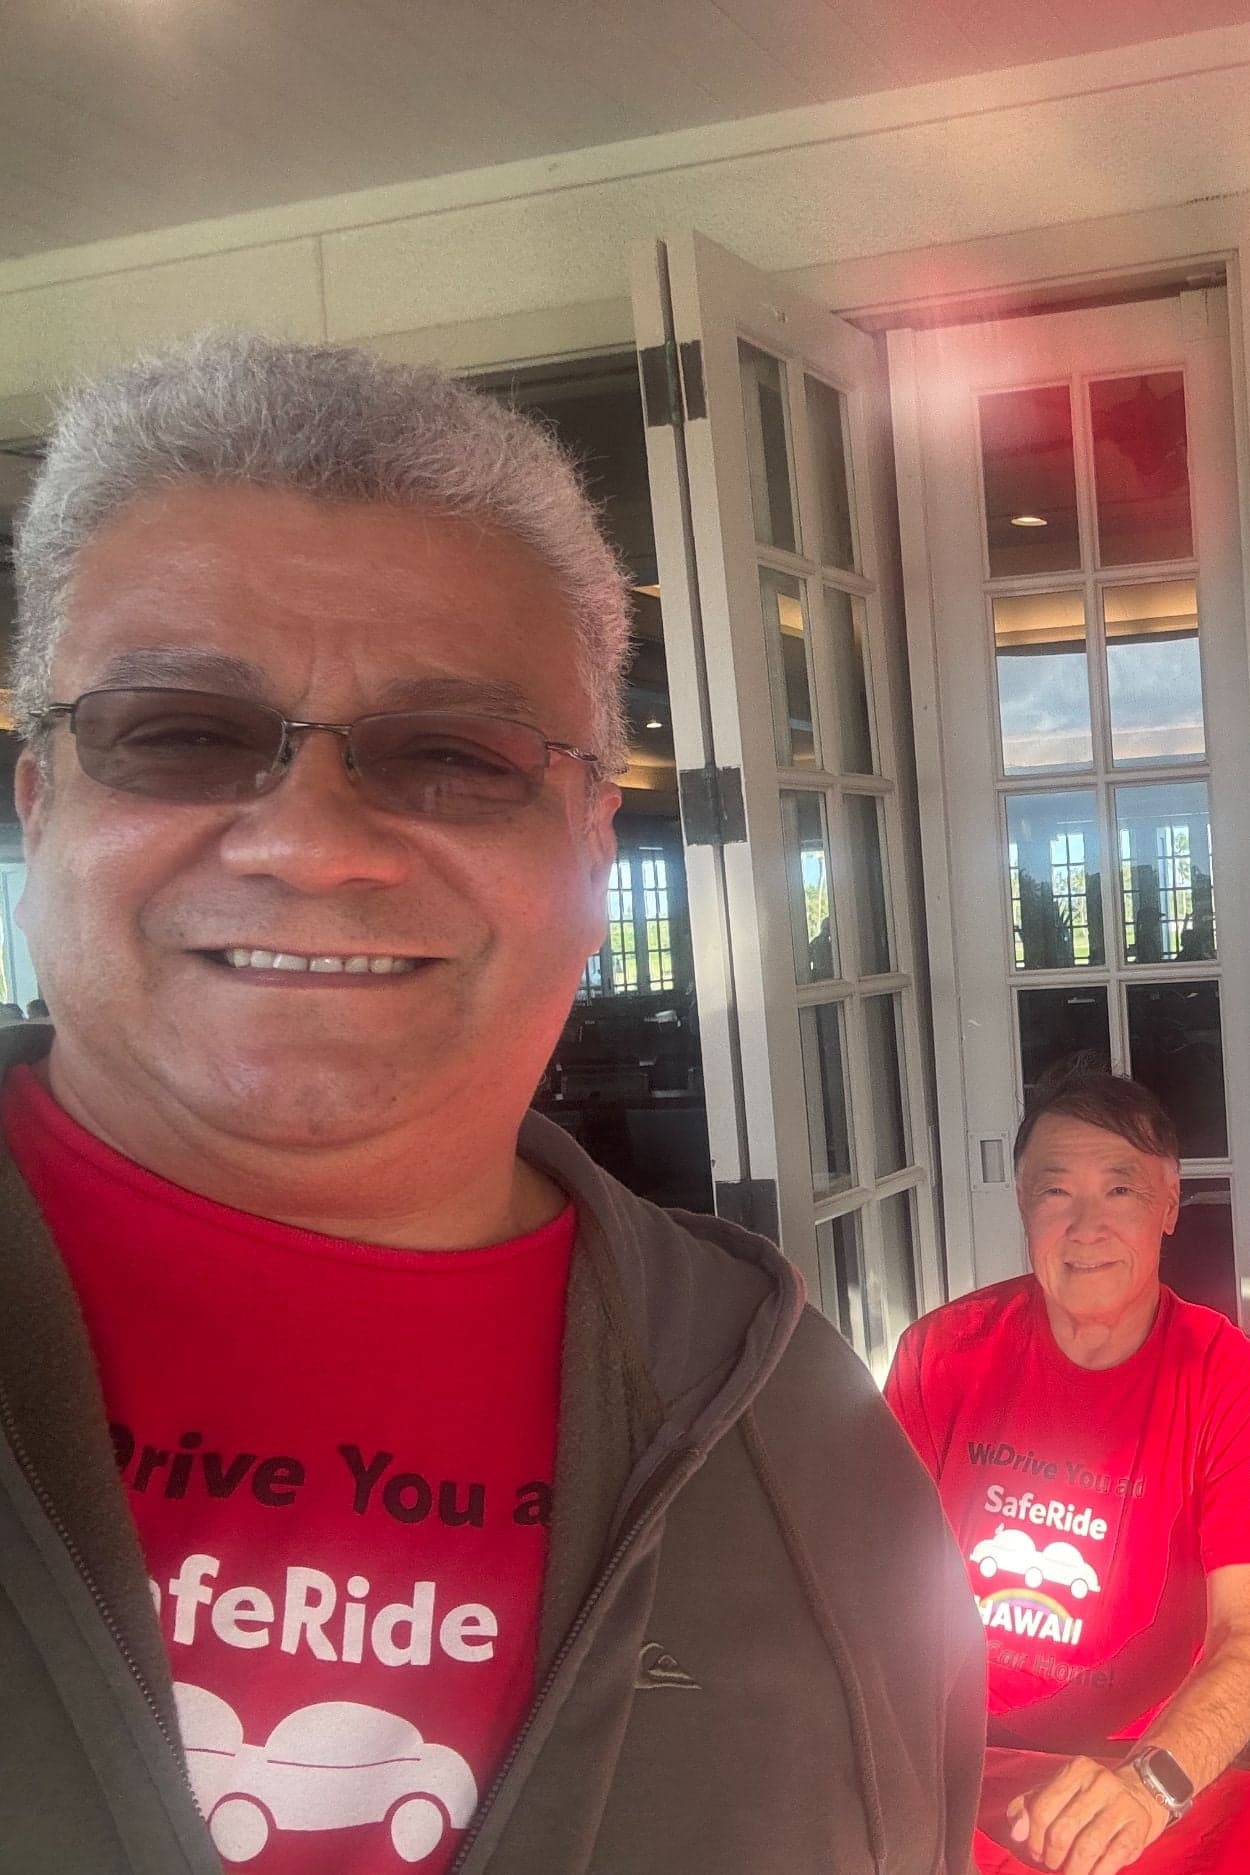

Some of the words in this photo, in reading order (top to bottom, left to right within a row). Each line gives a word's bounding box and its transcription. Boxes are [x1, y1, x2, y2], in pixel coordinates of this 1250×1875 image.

[337, 1443, 487, 1528] You
[993, 1443, 1058, 1479] Drive
[1065, 1461, 1109, 1493] You
[983, 1484, 1109, 1541] SafeRide
[150, 1553, 499, 1667] feRide
[973, 1594, 1083, 1647] HAWAII
